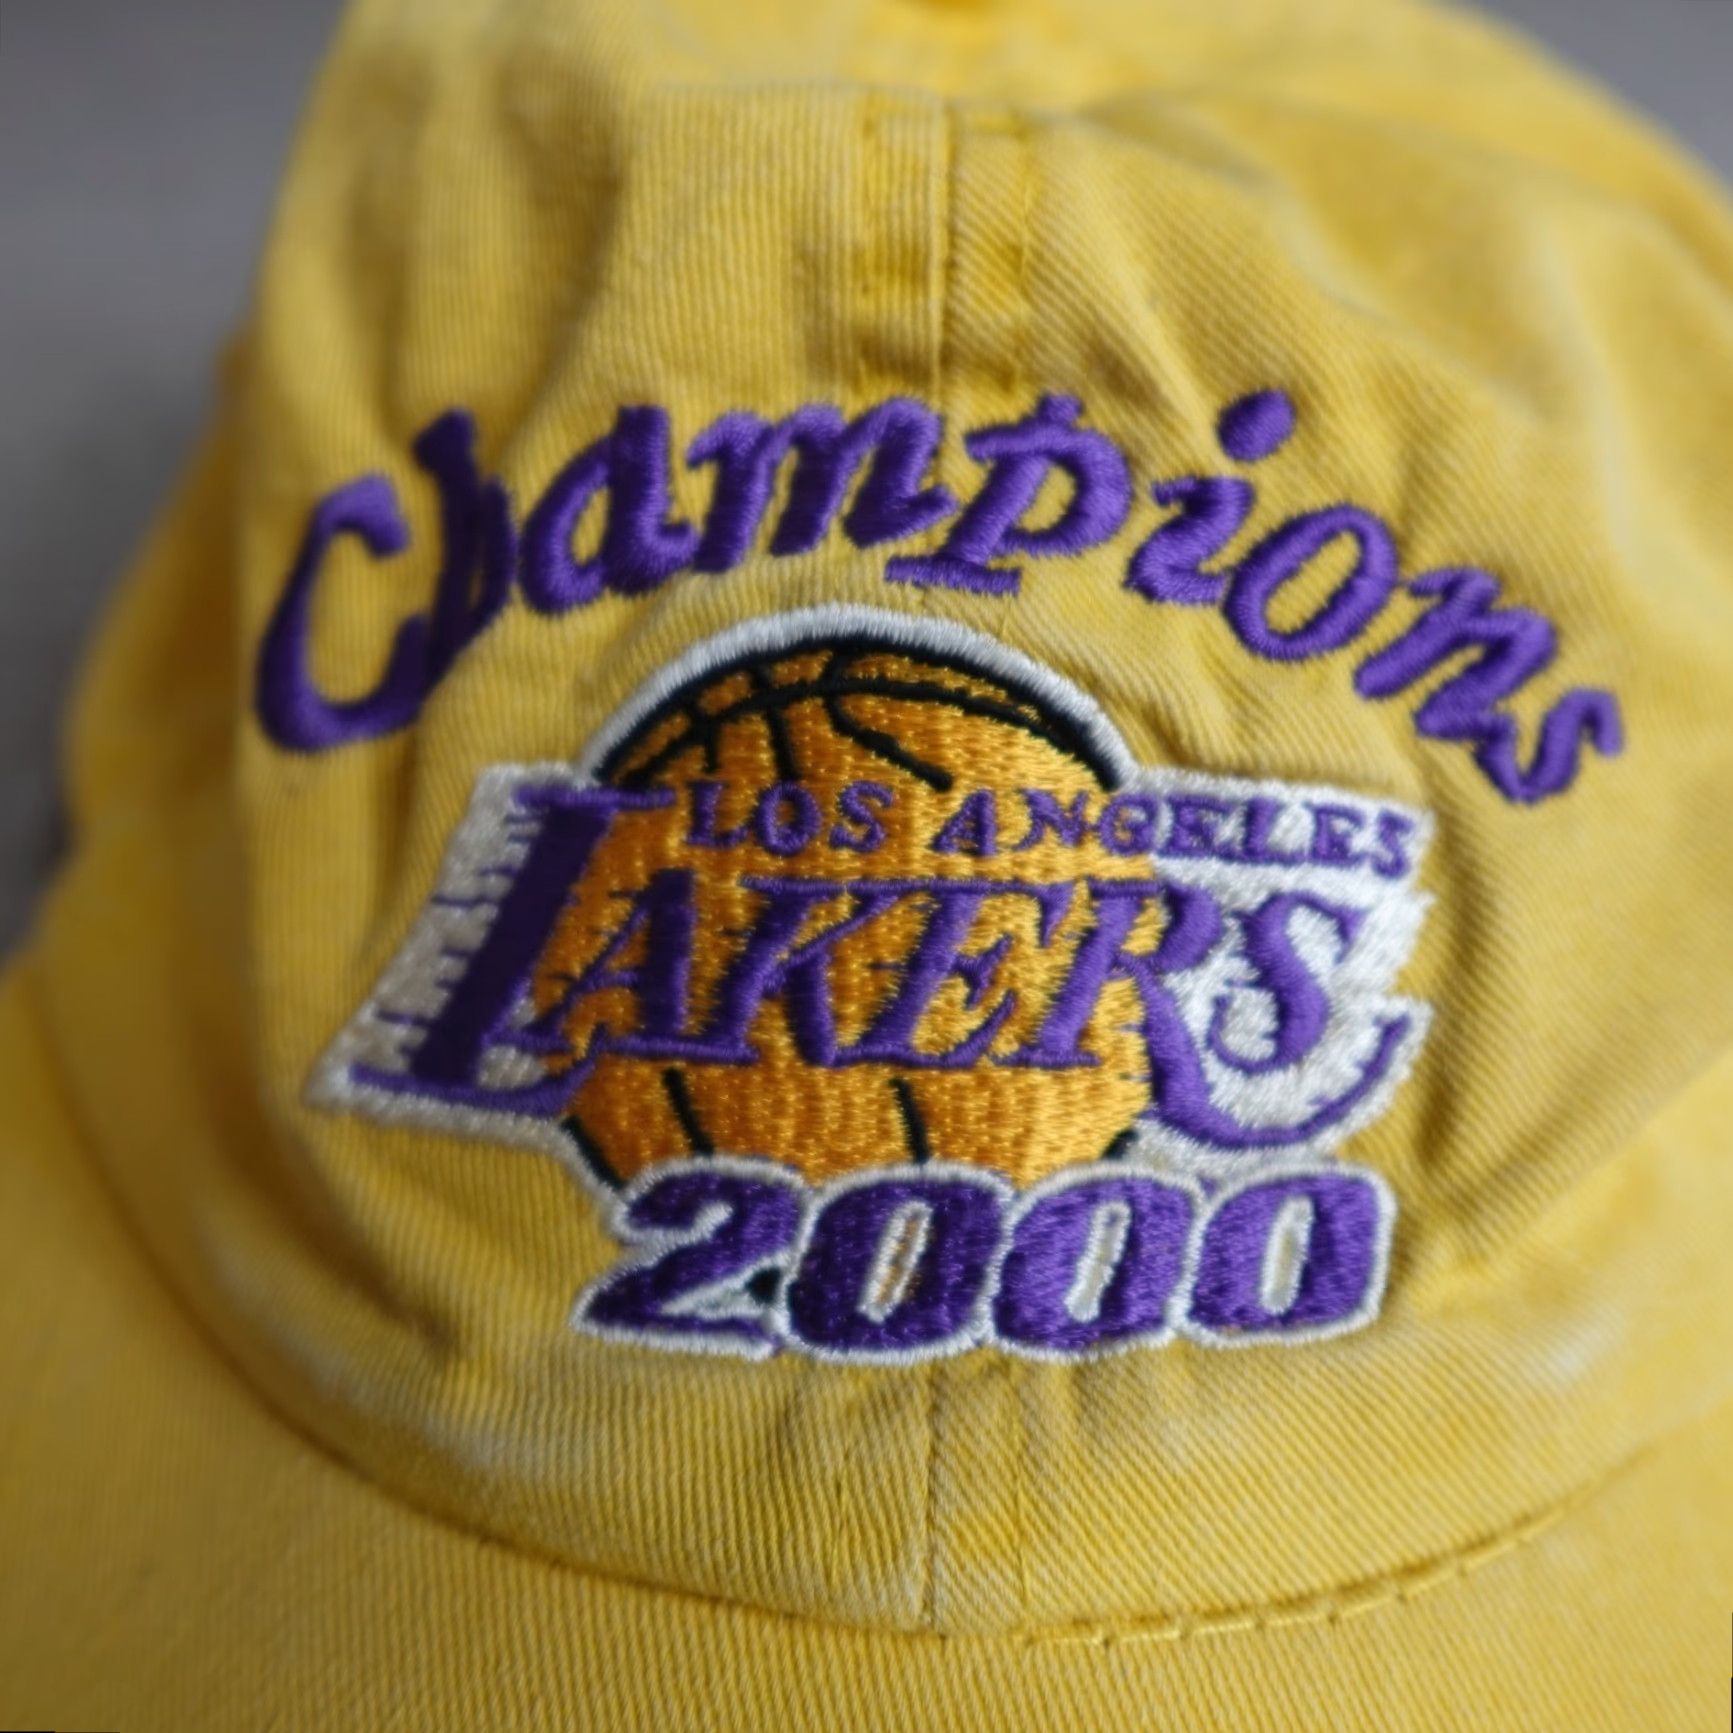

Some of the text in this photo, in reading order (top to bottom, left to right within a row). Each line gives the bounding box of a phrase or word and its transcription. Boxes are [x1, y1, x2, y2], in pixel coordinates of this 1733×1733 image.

[257, 389, 1620, 803] Champions
[350, 782, 1408, 1152] LAKERS
[687, 781, 1412, 881] LOS ANGELES
[582, 1168, 1382, 1355] 2000
